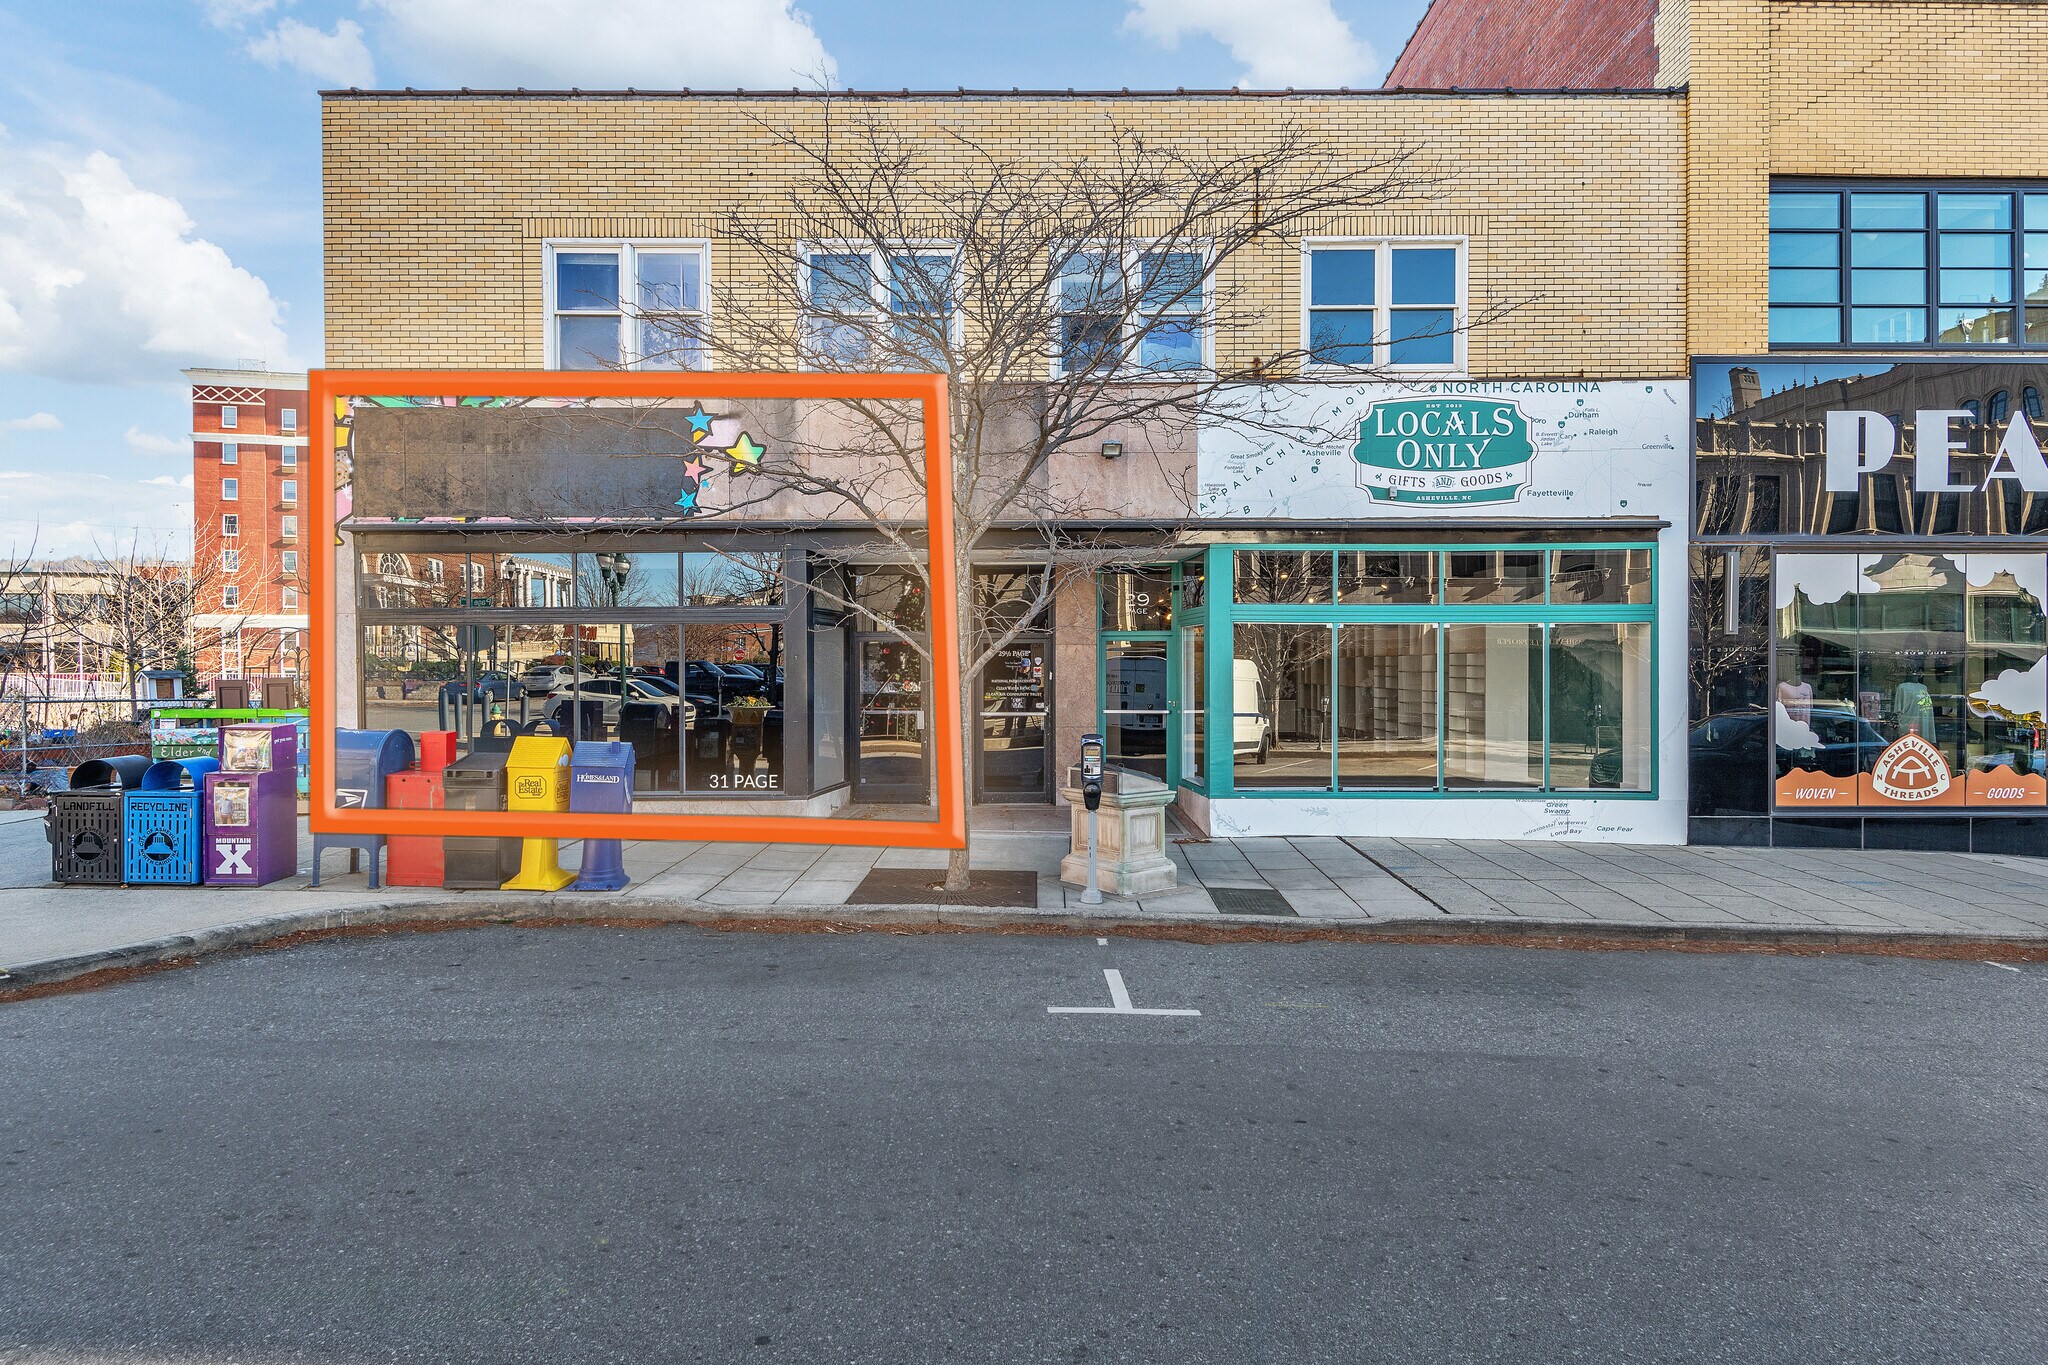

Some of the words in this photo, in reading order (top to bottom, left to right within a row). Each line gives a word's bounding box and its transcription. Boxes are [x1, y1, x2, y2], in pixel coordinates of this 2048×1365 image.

[1443, 382, 1502, 393] NORTH
[1511, 382, 1601, 393] CAROLINA
[1375, 407, 1515, 437] LOCALS
[1588, 428, 1618, 436] Raleigh
[1396, 437, 1493, 469] ONLY
[1389, 474, 1426, 487] GIFTS
[1435, 477, 1453, 487] AND
[1460, 473, 1503, 487] GOODS
[1527, 489, 1574, 497] Fayetteville
[160, 746, 194, 757] Elder
[197, 746, 213, 757] and
[1882, 739, 1940, 768] ASHEVILLE
[524, 778, 542, 787] Real
[1877, 773, 1883, 781] N
[1940, 773, 1946, 781] C
[518, 786, 543, 794] Estate
[1795, 788, 1836, 799] WOVEN
[1883, 786, 1939, 799] THREADS
[1987, 788, 2025, 799] GOODS
[63, 801, 115, 811] LANDFILL
[131, 802, 188, 812] RECYCLING
[155, 827, 178, 846] ASHEVILLE
[1550, 829, 1567, 837] Long
[155, 850, 178, 866] CAROLINA
[215, 844, 252, 874] X
